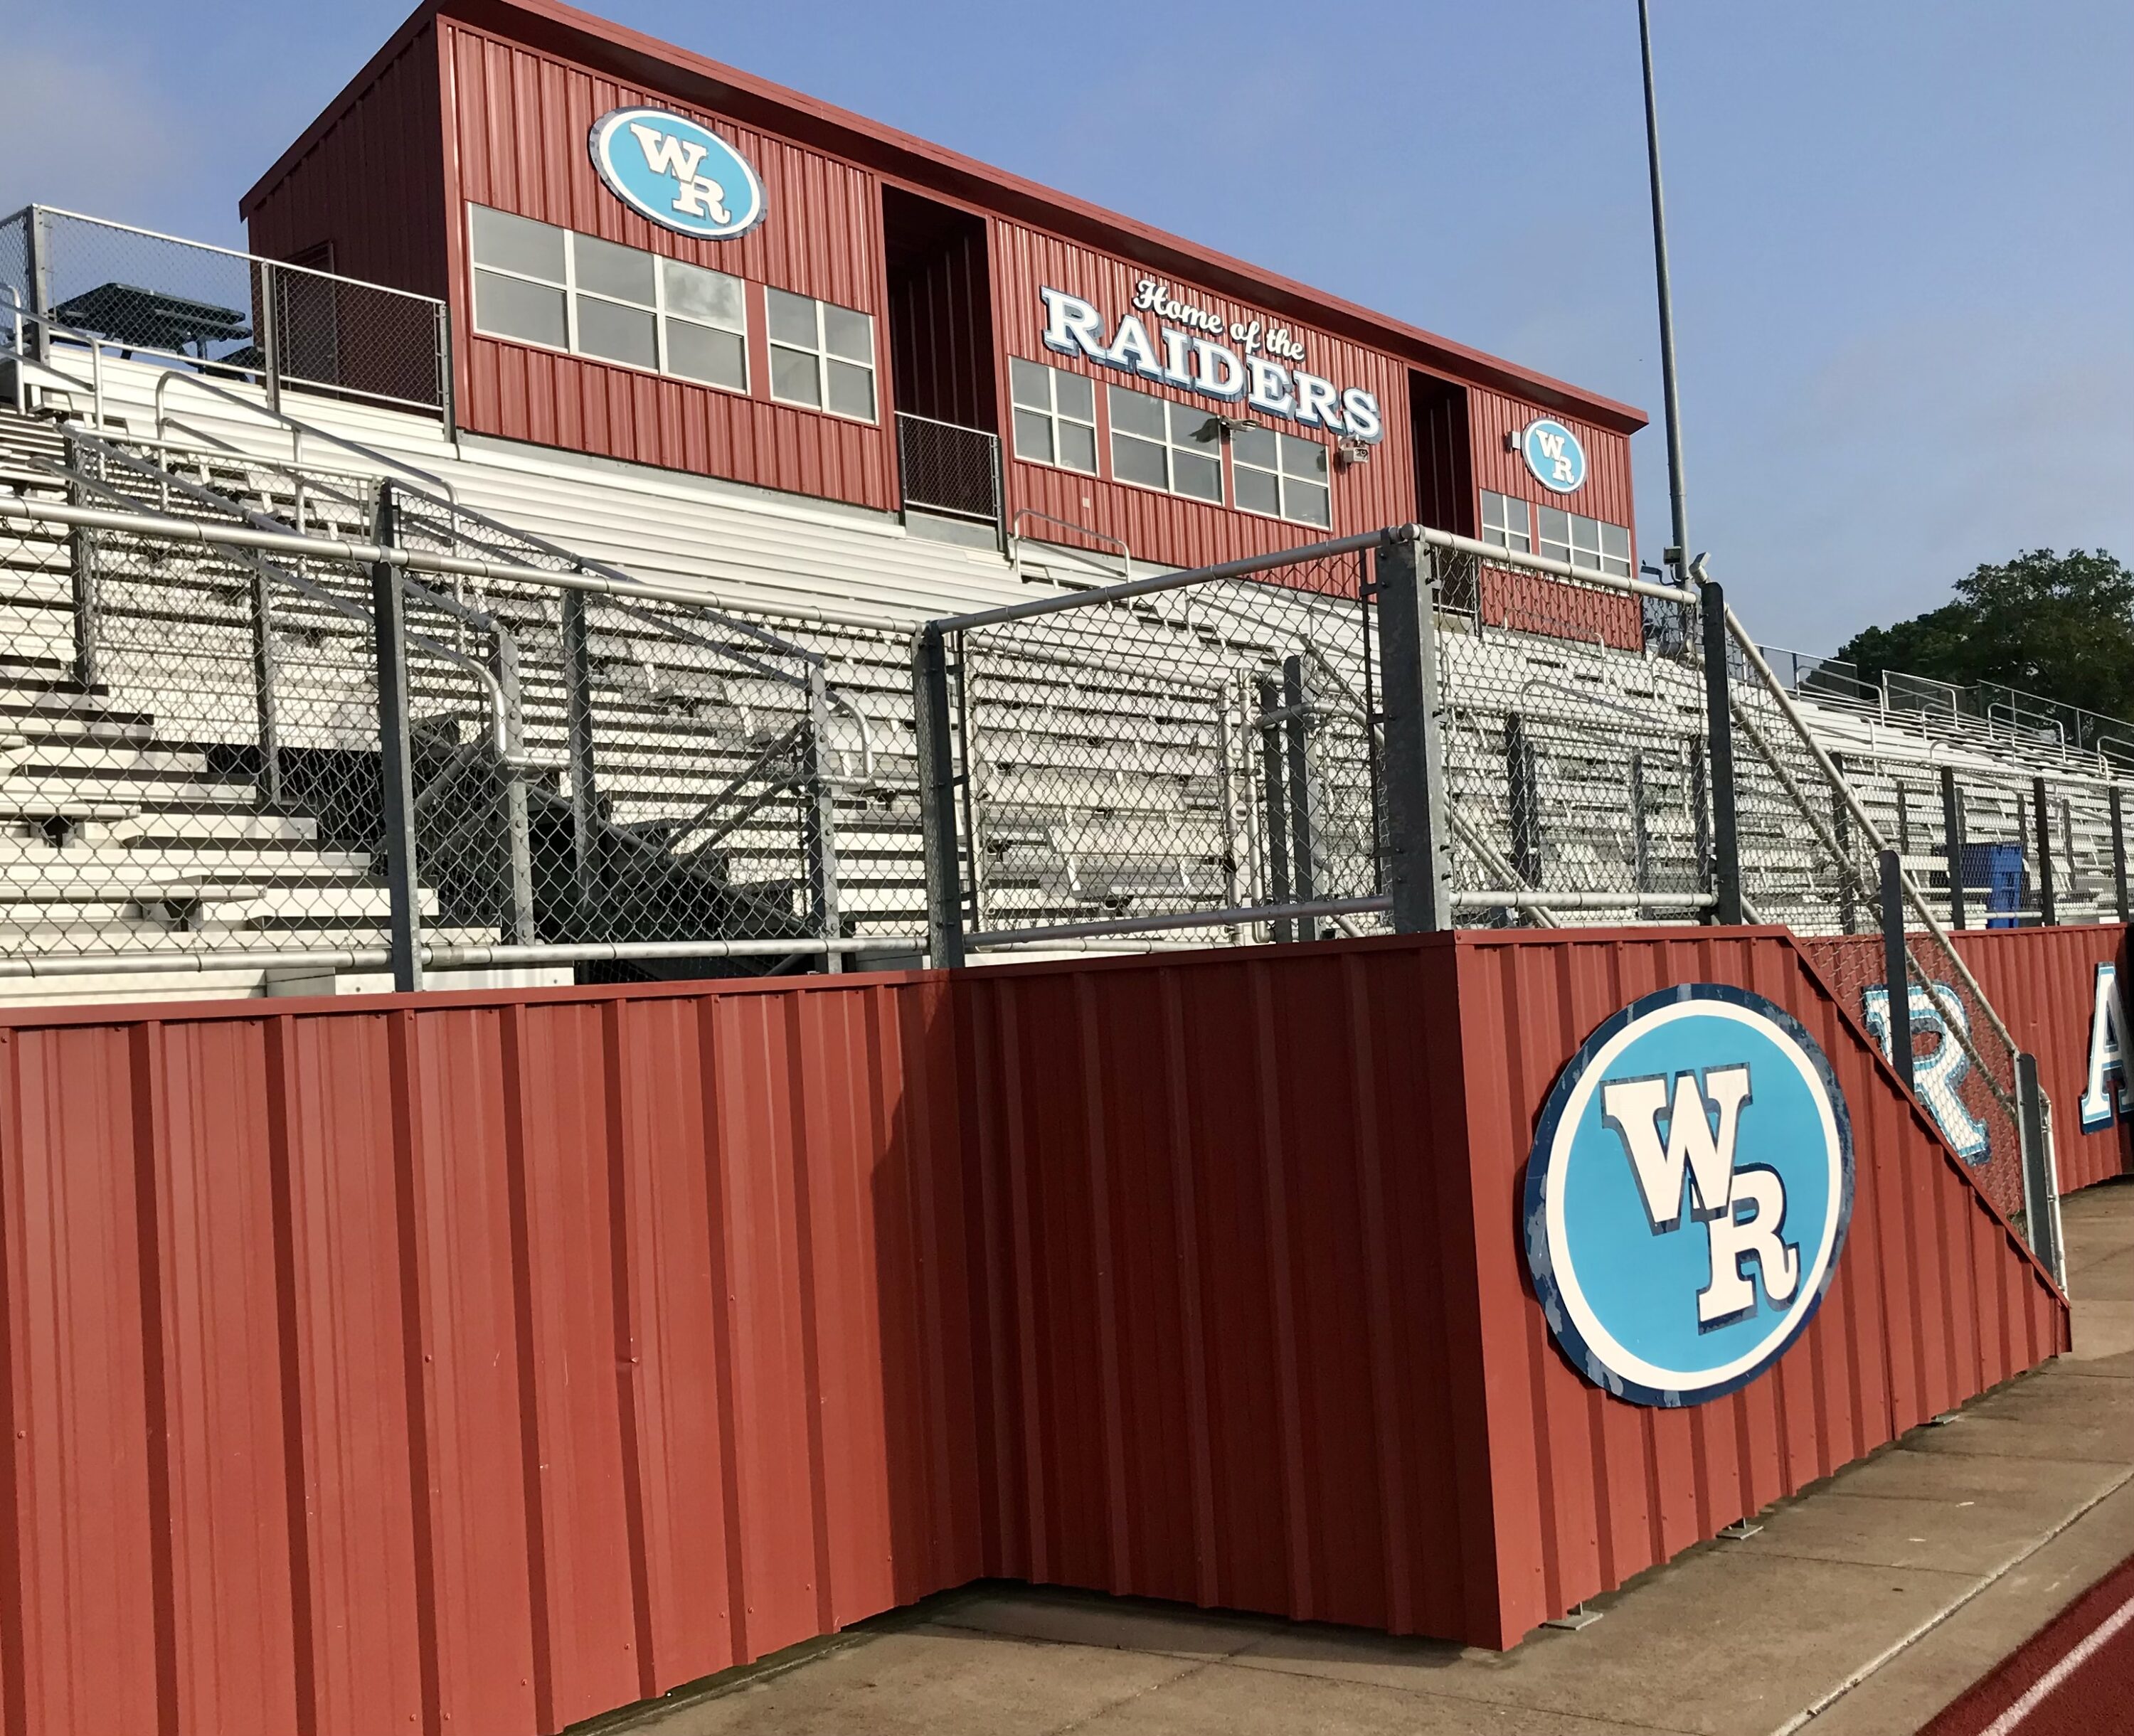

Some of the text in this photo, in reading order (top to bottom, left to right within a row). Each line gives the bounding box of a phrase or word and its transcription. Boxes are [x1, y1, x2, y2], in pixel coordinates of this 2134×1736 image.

[1041, 285, 1382, 445] RAIDERS
[1133, 279, 1305, 361] Home of the
